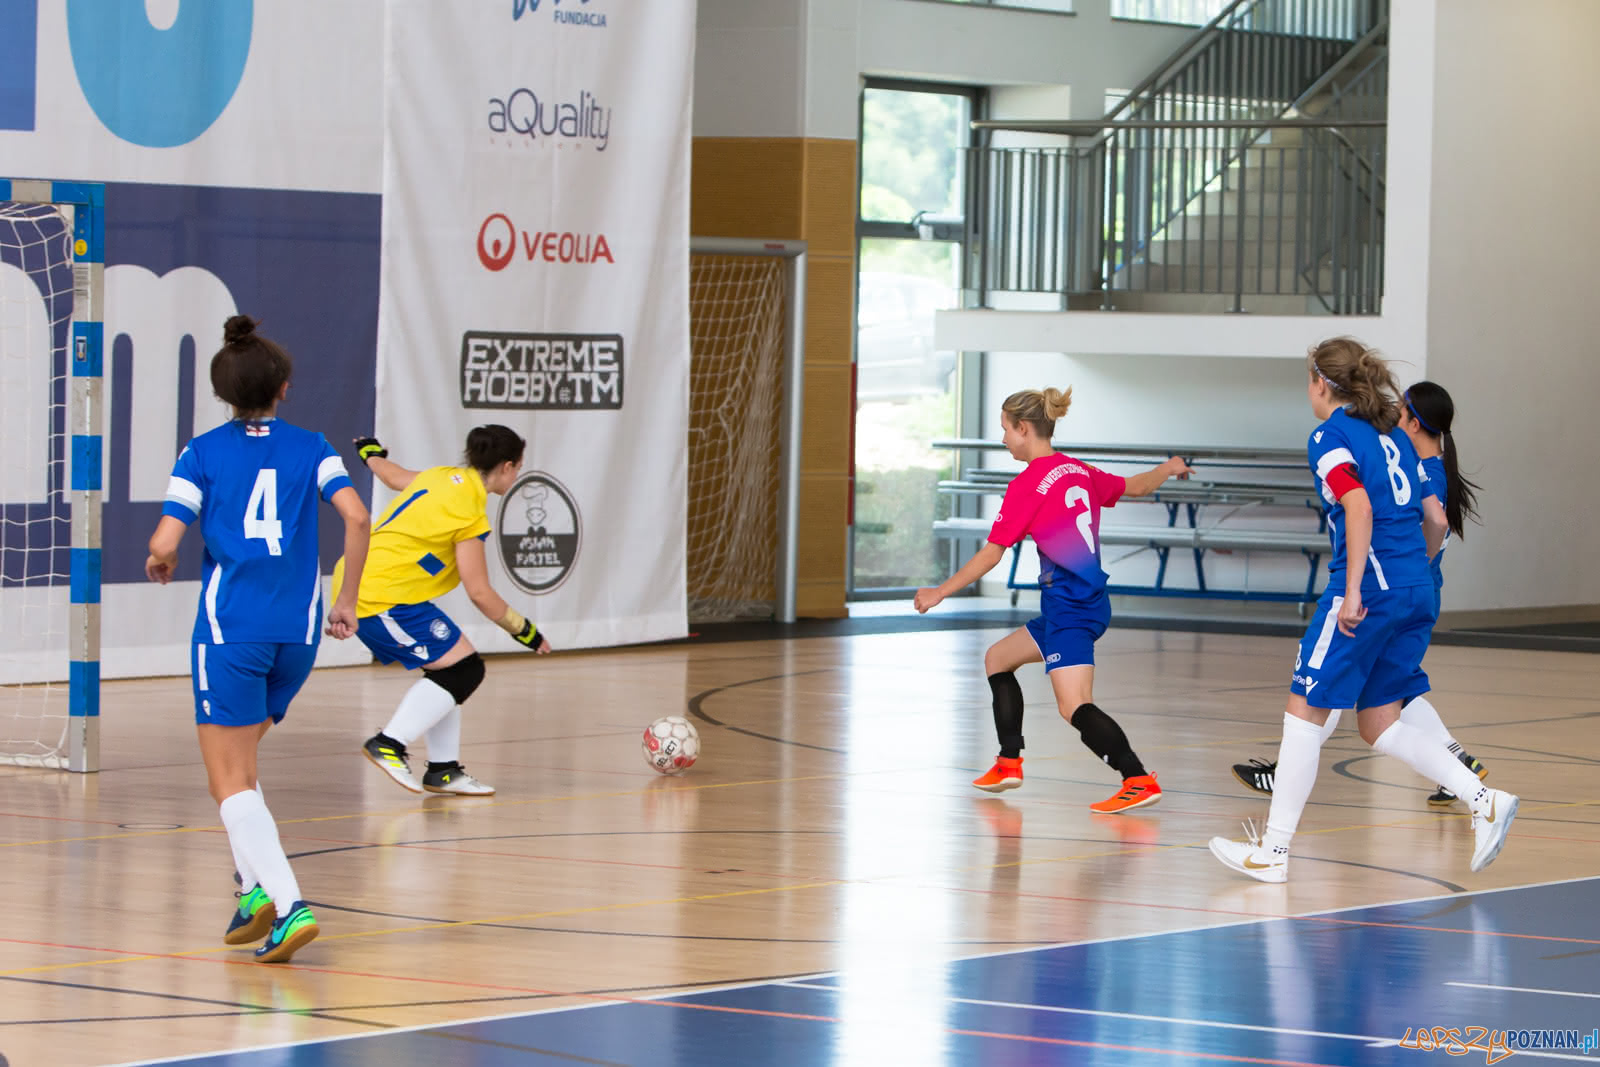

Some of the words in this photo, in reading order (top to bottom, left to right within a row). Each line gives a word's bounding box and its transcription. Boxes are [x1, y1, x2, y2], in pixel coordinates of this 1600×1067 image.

[553, 9, 608, 27] FUNDACJA
[488, 87, 611, 151] aQuality
[522, 230, 615, 265] VEOLIA
[464, 337, 620, 373] EXTREME
[463, 370, 562, 404] HOBBY
[1378, 433, 1412, 506] 8
[243, 468, 283, 556] 4
[1064, 485, 1096, 555] 2
